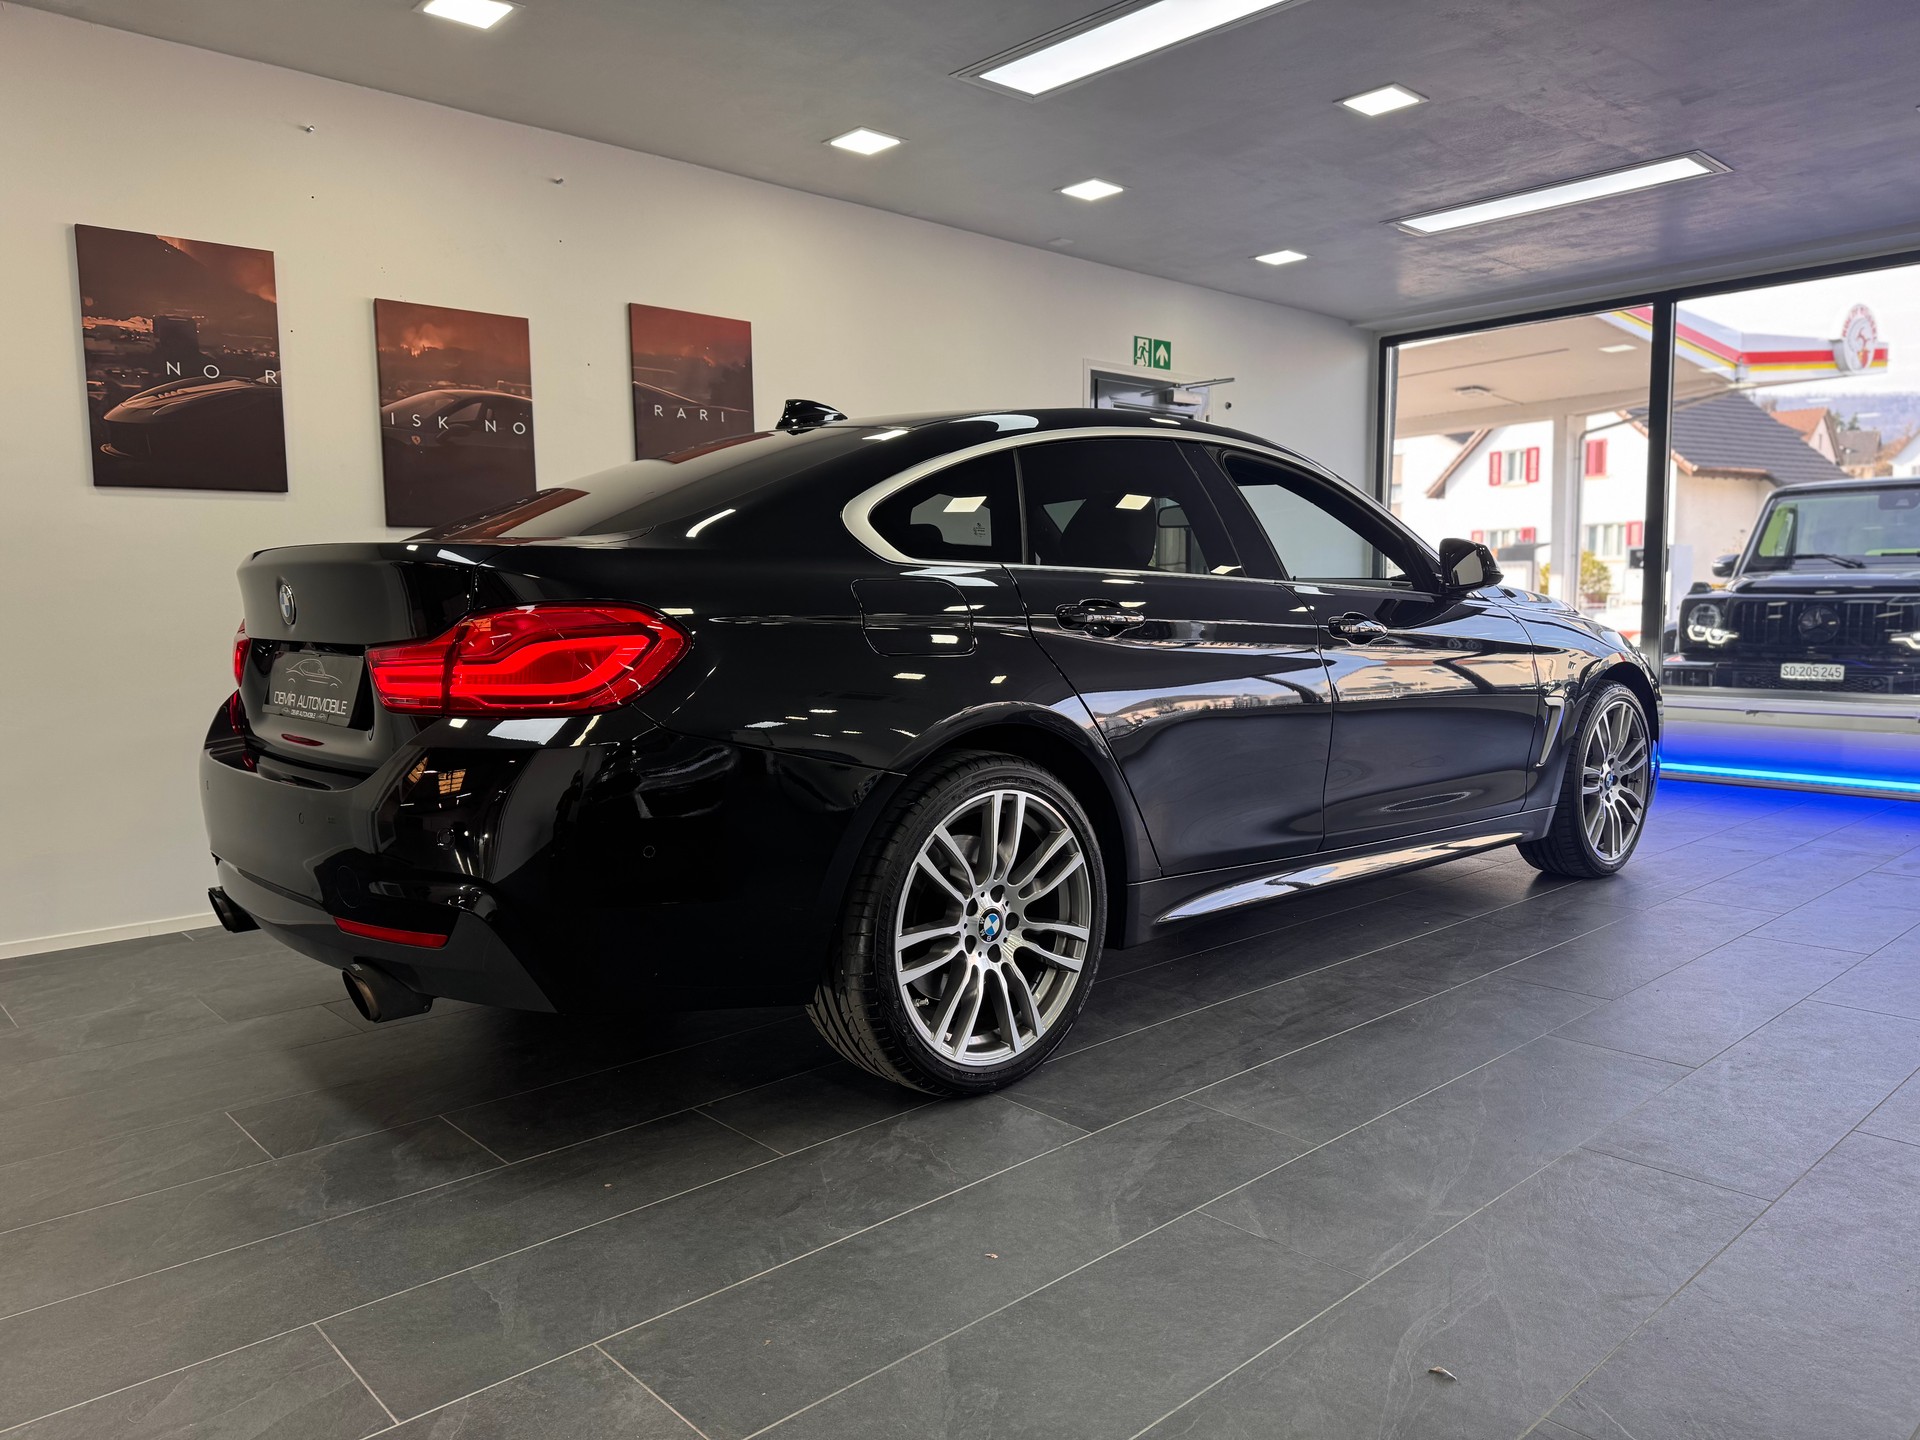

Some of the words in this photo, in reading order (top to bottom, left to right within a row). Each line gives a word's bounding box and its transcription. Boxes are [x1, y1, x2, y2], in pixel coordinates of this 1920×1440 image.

[166, 361, 220, 379] NO
[265, 369, 277, 384] R
[391, 402, 449, 430] ISK
[485, 419, 526, 435] NO
[654, 404, 726, 423] RARI
[1820, 666, 1842, 678] 245
